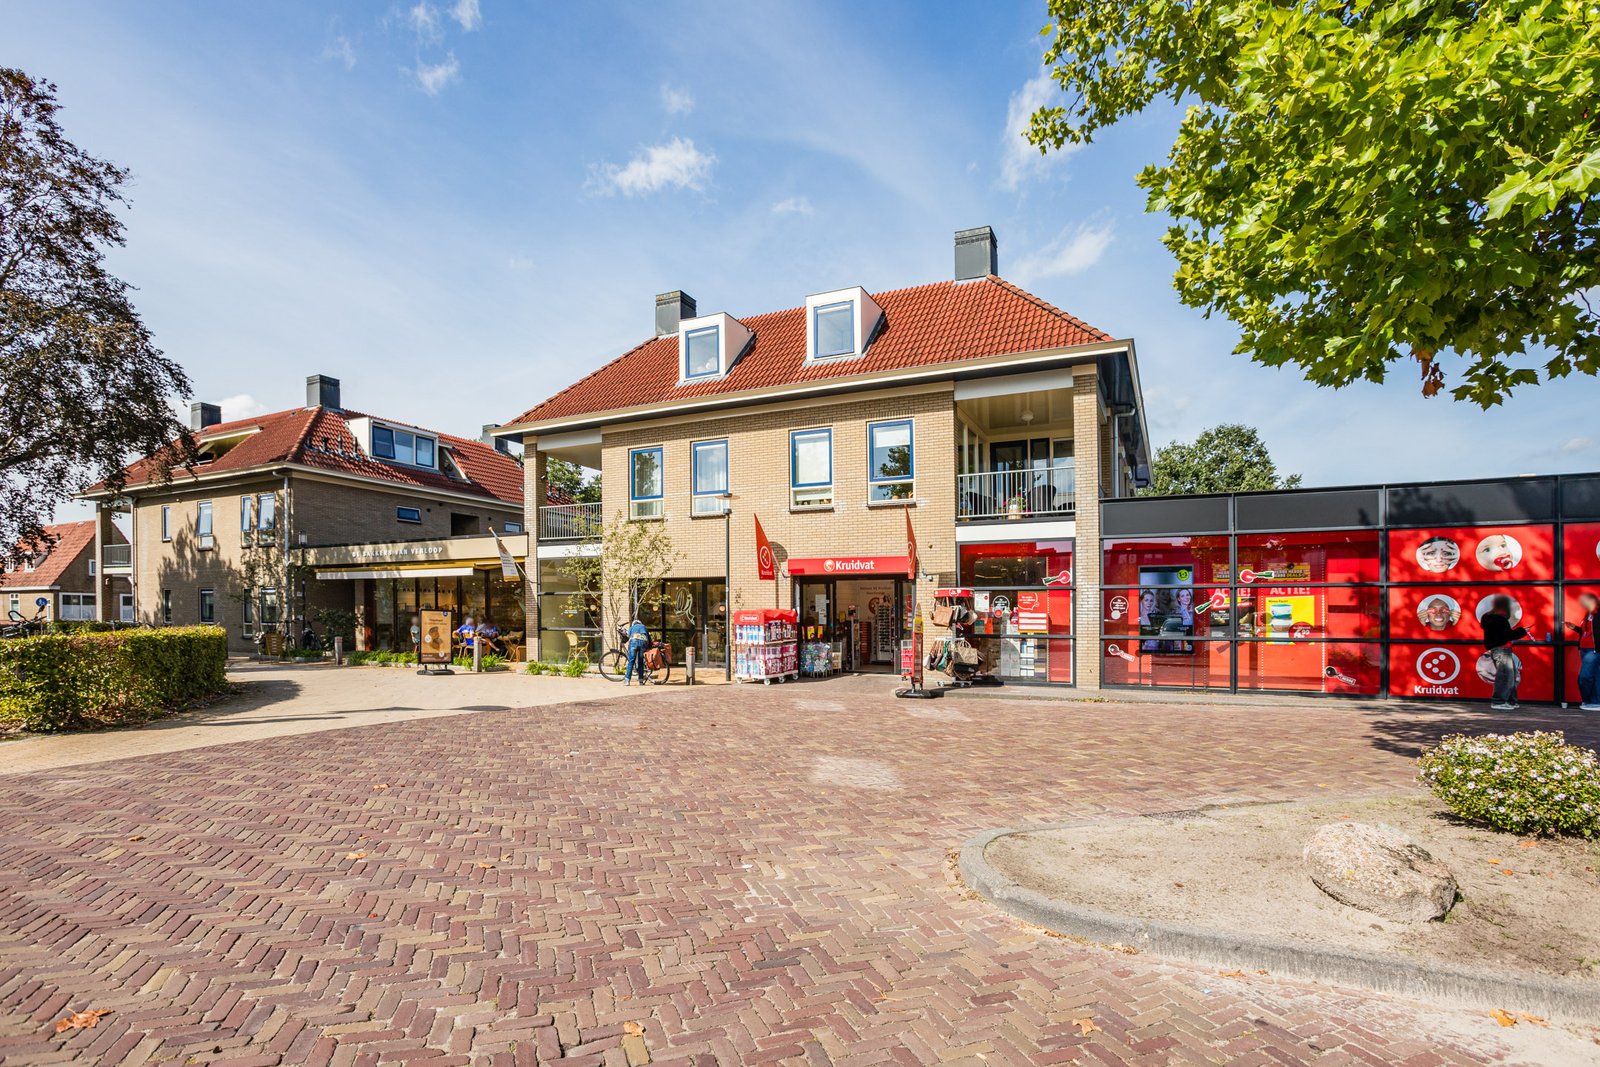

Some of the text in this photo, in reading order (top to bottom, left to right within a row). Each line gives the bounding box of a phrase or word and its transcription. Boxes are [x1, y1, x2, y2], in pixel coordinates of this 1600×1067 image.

[411, 547, 443, 555] VERLOOP
[835, 560, 875, 570] Kruidvat
[1414, 685, 1459, 695] Kruidvat
